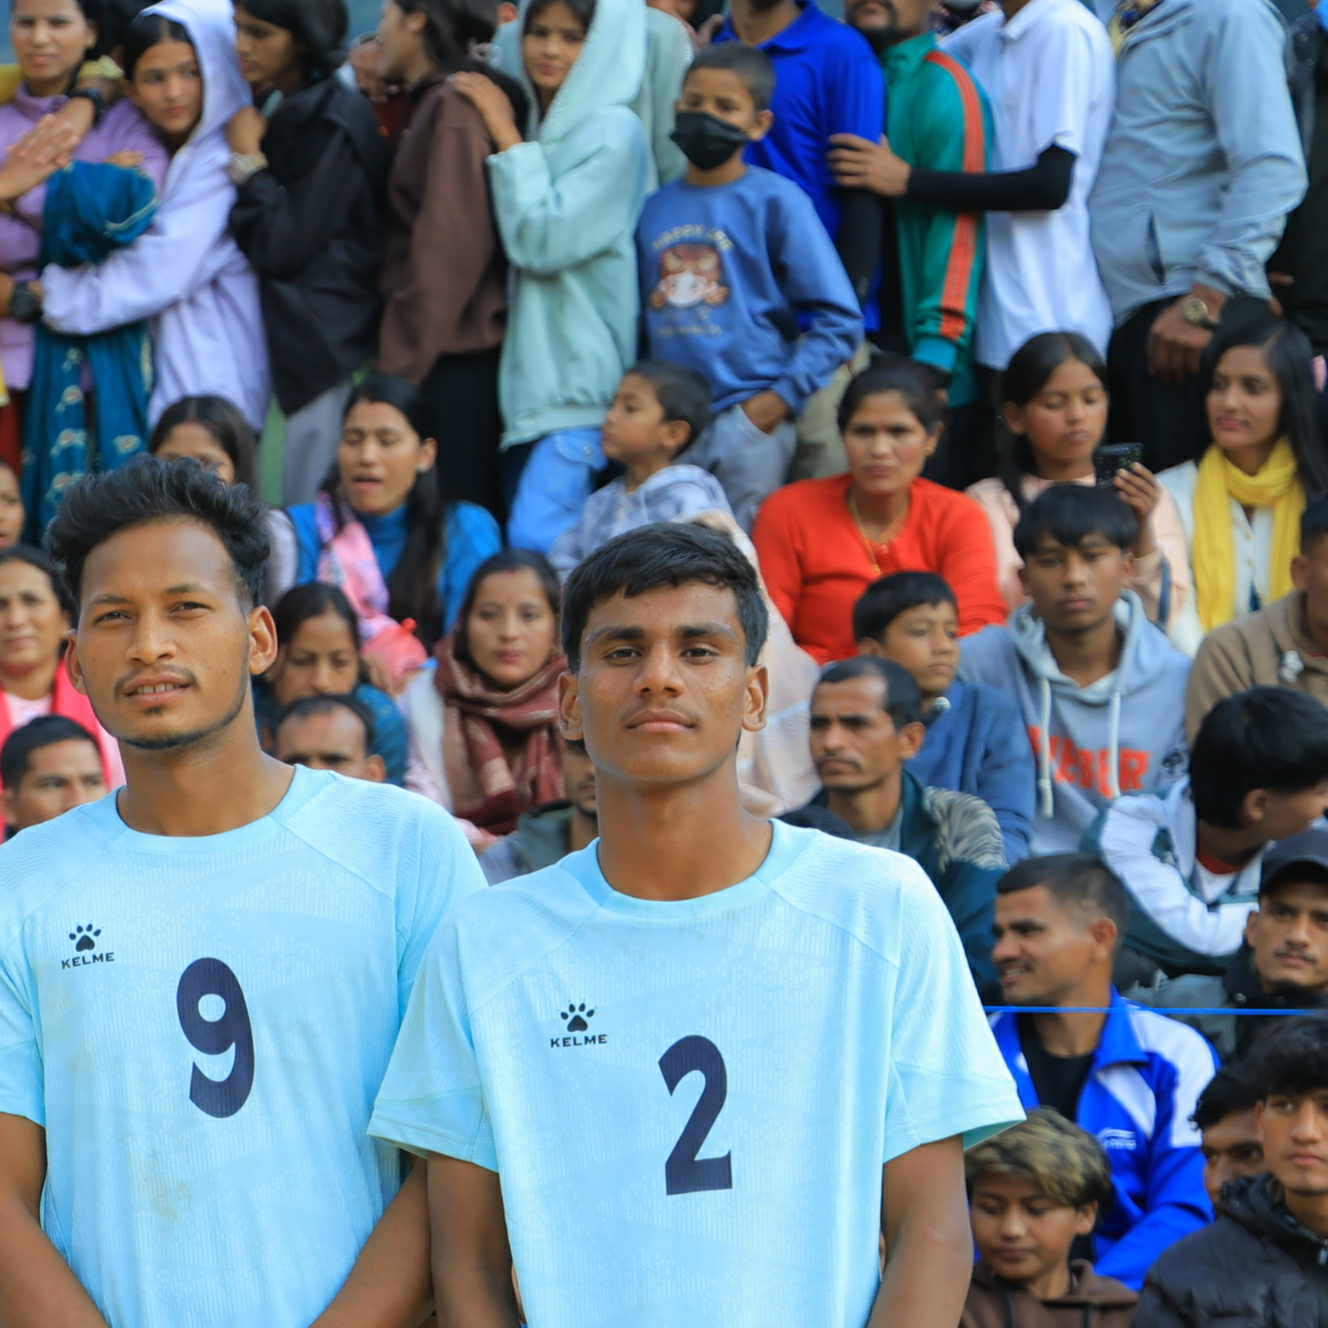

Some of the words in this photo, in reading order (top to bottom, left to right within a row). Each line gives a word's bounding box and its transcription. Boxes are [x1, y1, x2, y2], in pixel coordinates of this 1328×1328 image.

[60, 952, 115, 970] KELME
[177, 957, 255, 1119] 9
[550, 1033, 608, 1049] KELME
[658, 1034, 733, 1196] 2
